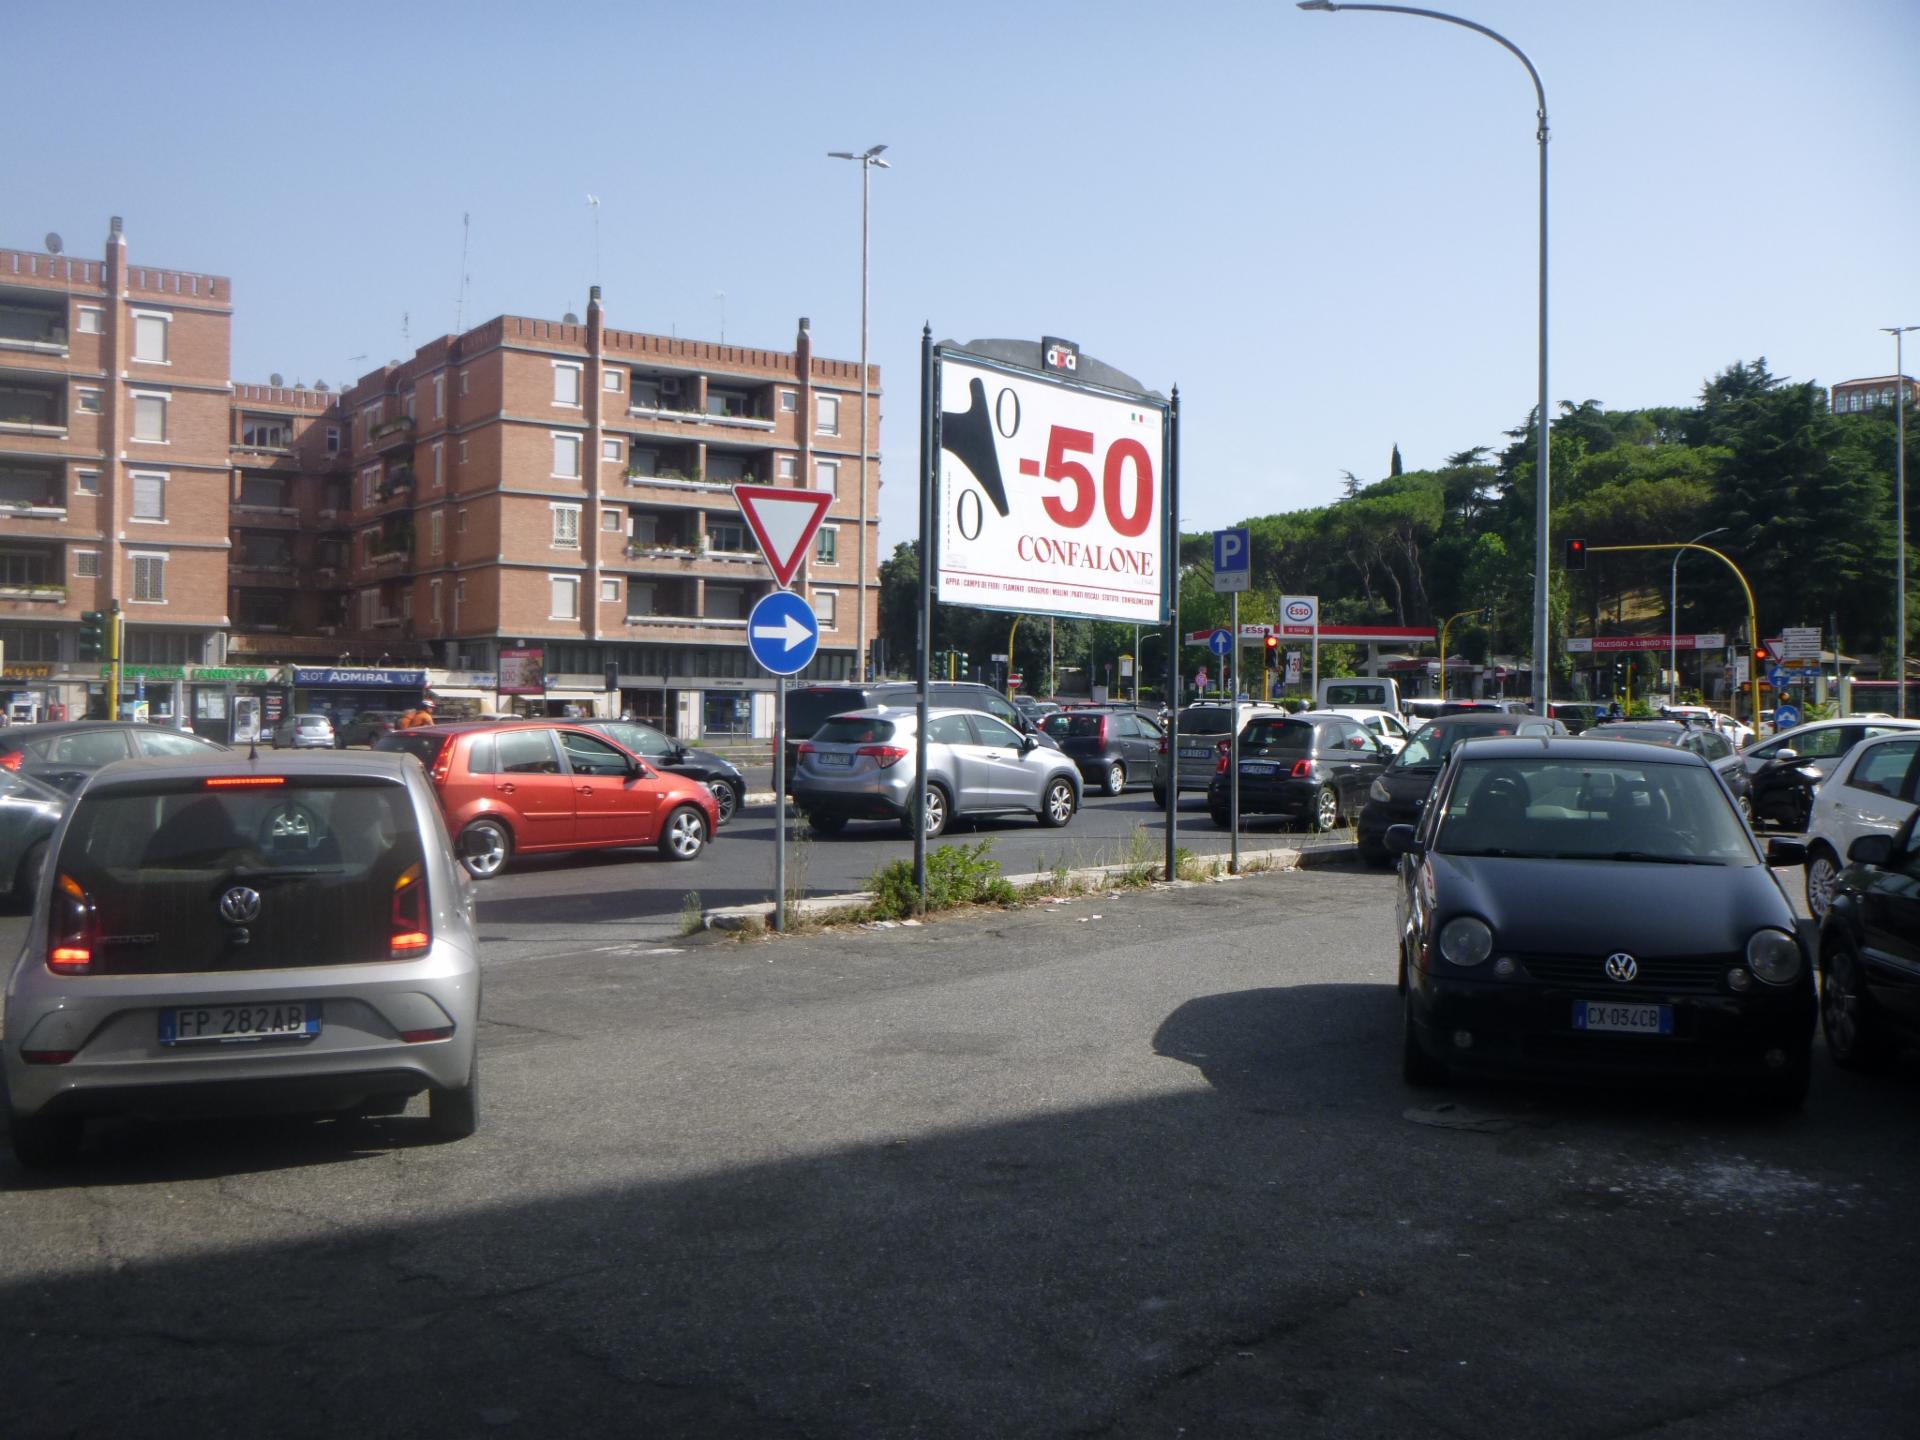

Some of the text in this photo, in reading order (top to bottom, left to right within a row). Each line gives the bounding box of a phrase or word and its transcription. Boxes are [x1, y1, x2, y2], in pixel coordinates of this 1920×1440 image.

[1017, 534, 1154, 577] CONFALONE
[1221, 535, 1241, 568] P
[1662, 638, 1694, 646] TEMINE
[300, 671, 417, 683] SLOT ADMIRAL VLT
